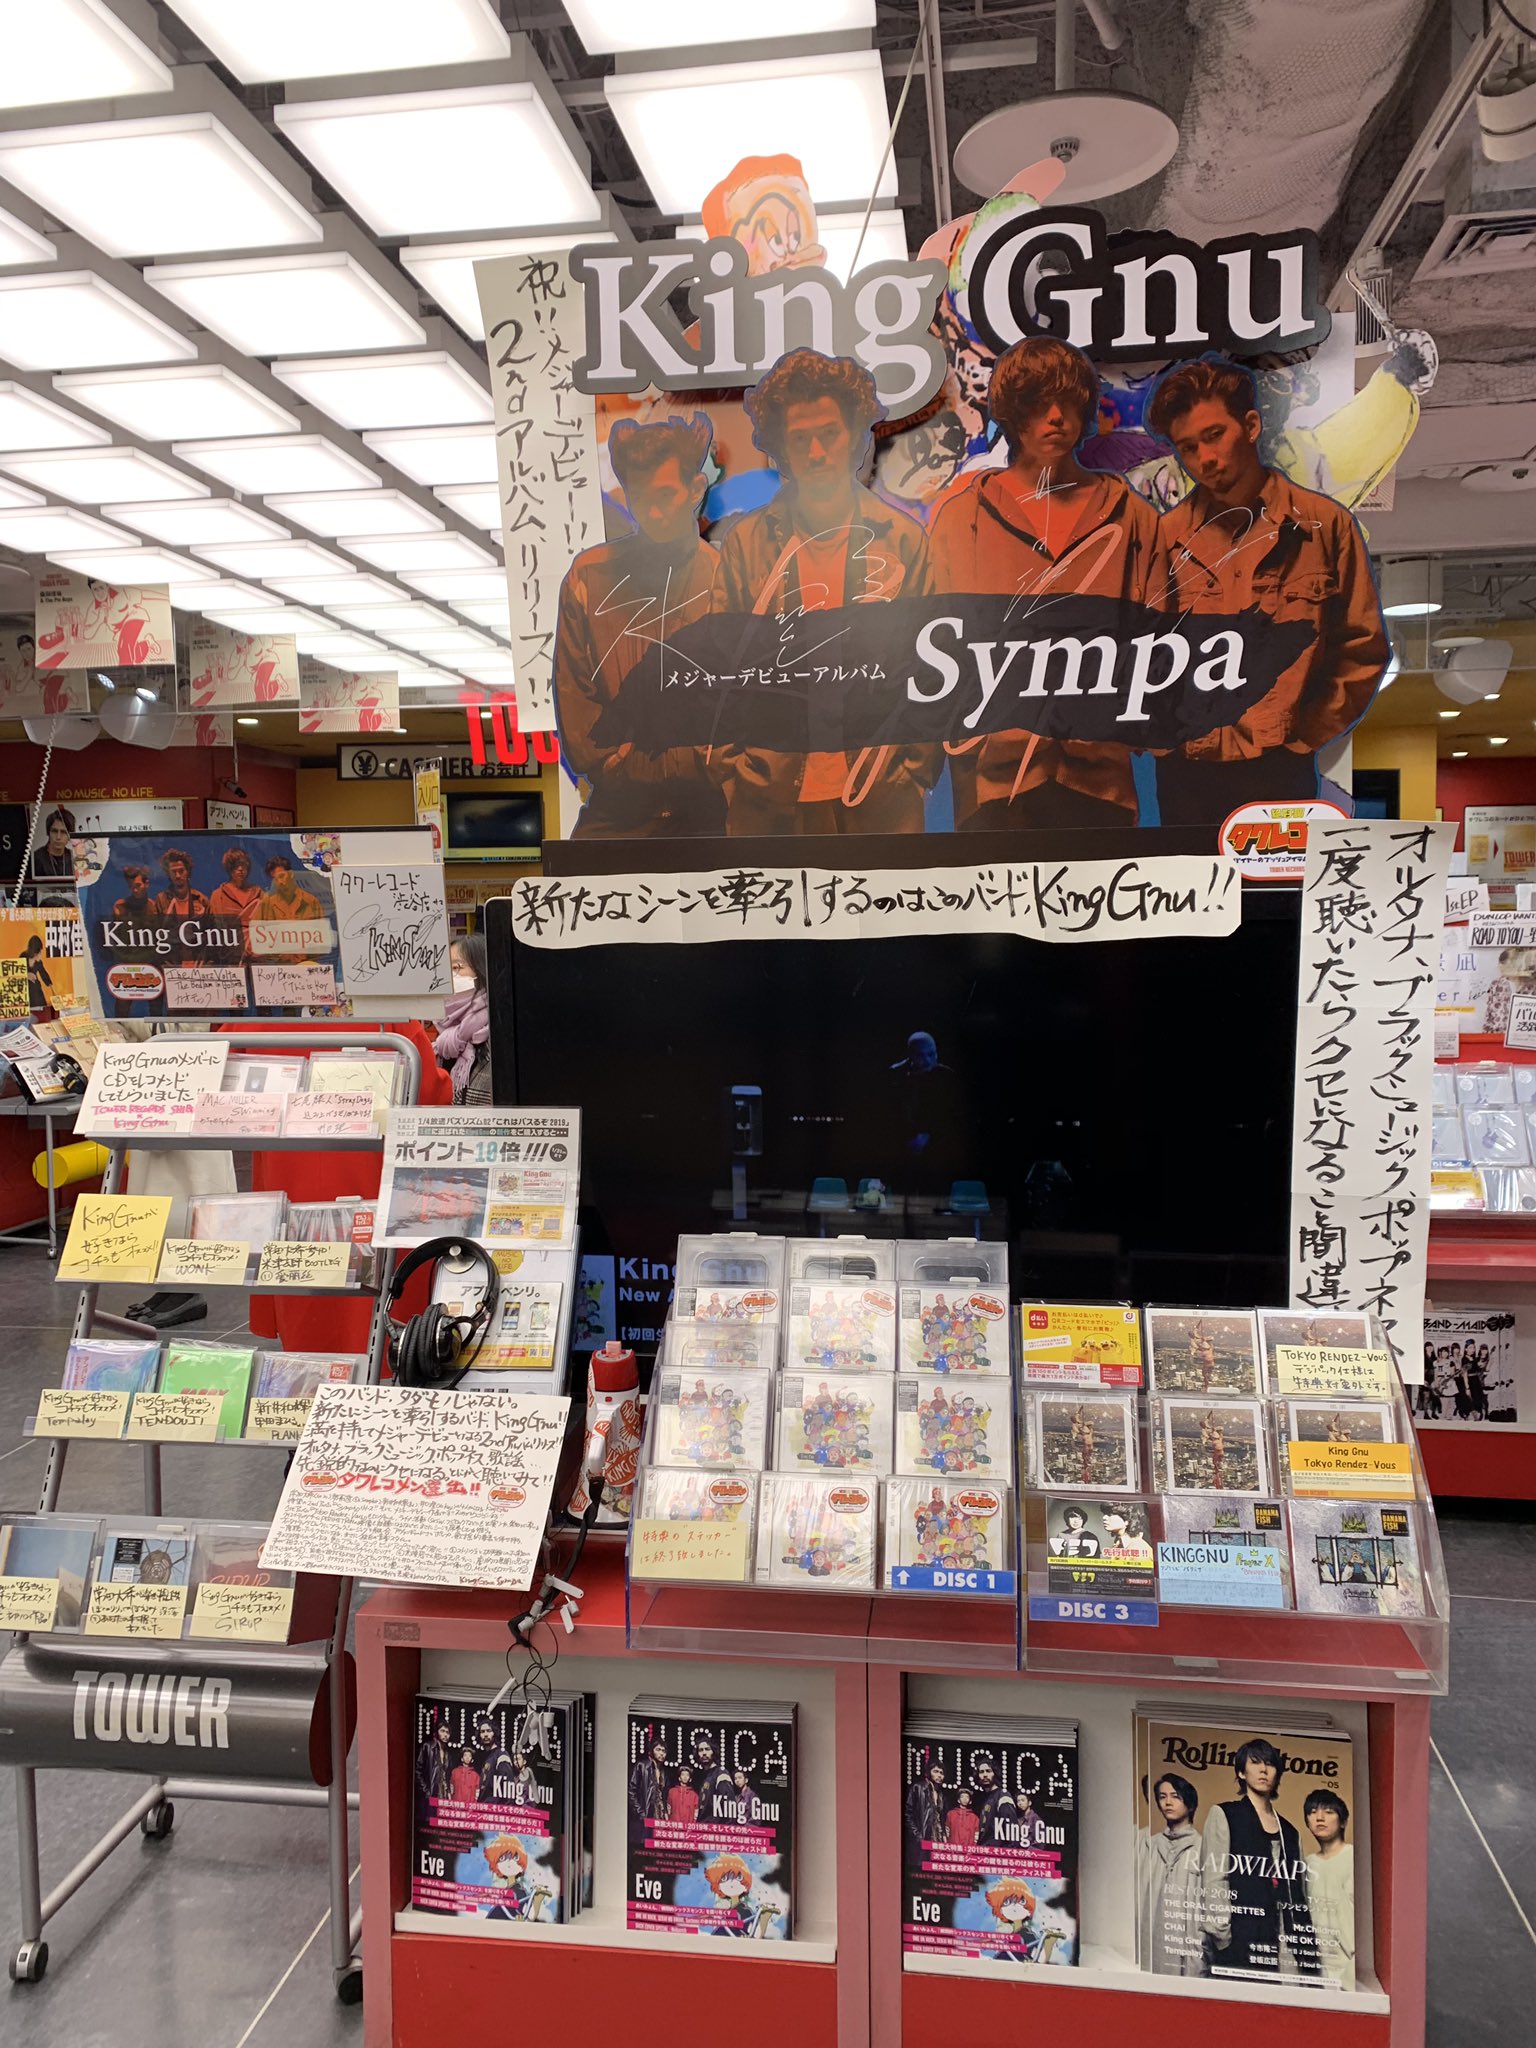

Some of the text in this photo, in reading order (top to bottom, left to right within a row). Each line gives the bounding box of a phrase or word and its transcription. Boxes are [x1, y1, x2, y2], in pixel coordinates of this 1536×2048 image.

[581, 220, 1315, 405] King Gnu
[665, 663, 886, 688] メジャーデビューアルバム
[908, 616, 1247, 728] Sympa
[57, 790, 72, 799] NO
[112, 788, 128, 798] NO
[101, 921, 325, 956] King Gnu Sympa
[619, 1286, 662, 1302] New
[1328, 1446, 1369, 1457] King Gnu
[1255, 1508, 1279, 1517] BANANA
[1256, 1516, 1271, 1524] FISH
[1382, 1514, 1406, 1523] BANANA
[1383, 1521, 1399, 1530] FISH
[932, 1571, 996, 1589] DISC 1
[1058, 1601, 1130, 1620] DISC 3
[72, 1669, 233, 1749] TOWER
[631, 1721, 788, 1775] MUSICA
[906, 1742, 1074, 1798] MUSICA
[1282, 1749, 1339, 1778] tone
[493, 1774, 524, 1802] King
[1327, 1780, 1340, 1789] 05
[712, 1794, 780, 1823] King Gnu
[993, 1816, 1066, 1847] King Gnu
[420, 1849, 445, 1877] Eve
[635, 1873, 662, 1900] Eve
[1210, 1888, 1238, 1900] 2018
[912, 1895, 941, 1923] Eve
[1163, 1899, 1265, 1917] THE ORAL CIGARETTES
[1163, 1910, 1230, 1925] SUPER BEAVER
[1163, 1922, 1186, 1932] CHAI
[1163, 1934, 1184, 1946] King
[1278, 1934, 1342, 1949] ONE OK ROCK
[1163, 1946, 1204, 1959] Tempalay
